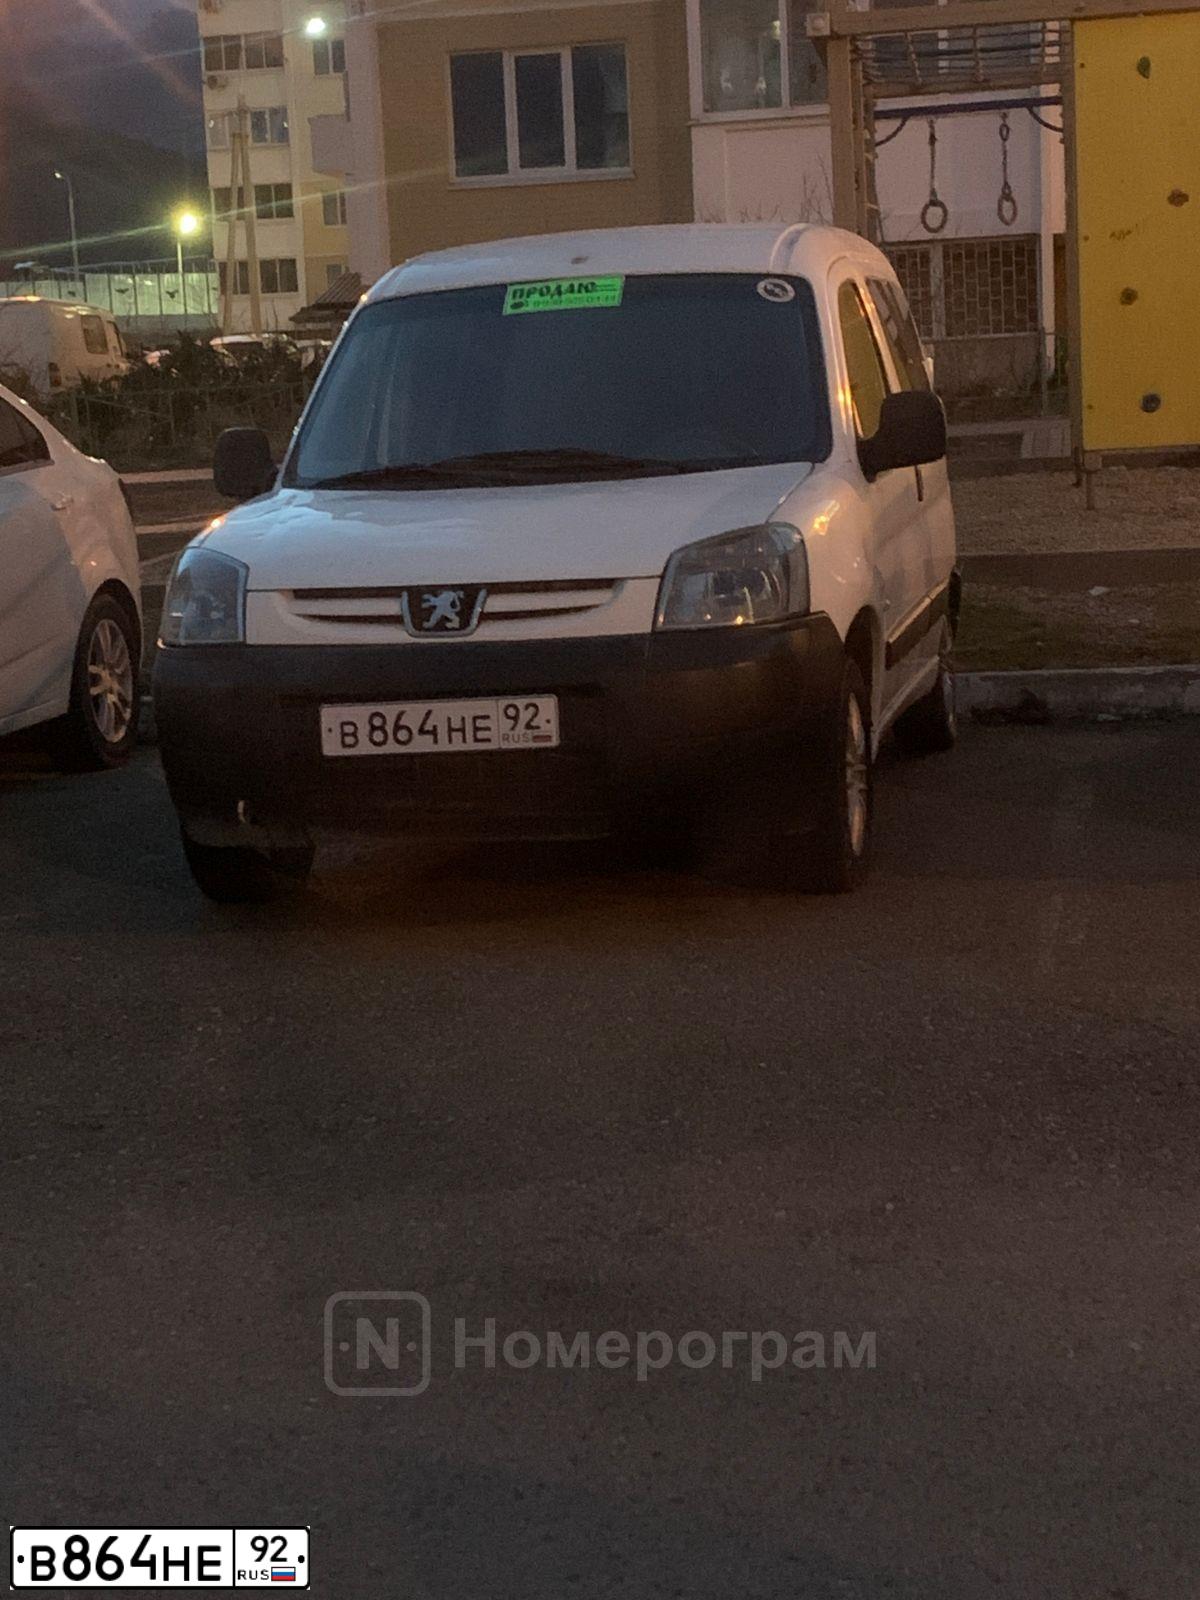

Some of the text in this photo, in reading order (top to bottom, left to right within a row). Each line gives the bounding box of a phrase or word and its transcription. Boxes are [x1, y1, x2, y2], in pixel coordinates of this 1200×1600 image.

[511, 281, 597, 300] ПРОДАЮ
[503, 702, 541, 731] 92
[501, 732, 531, 743] RUS
